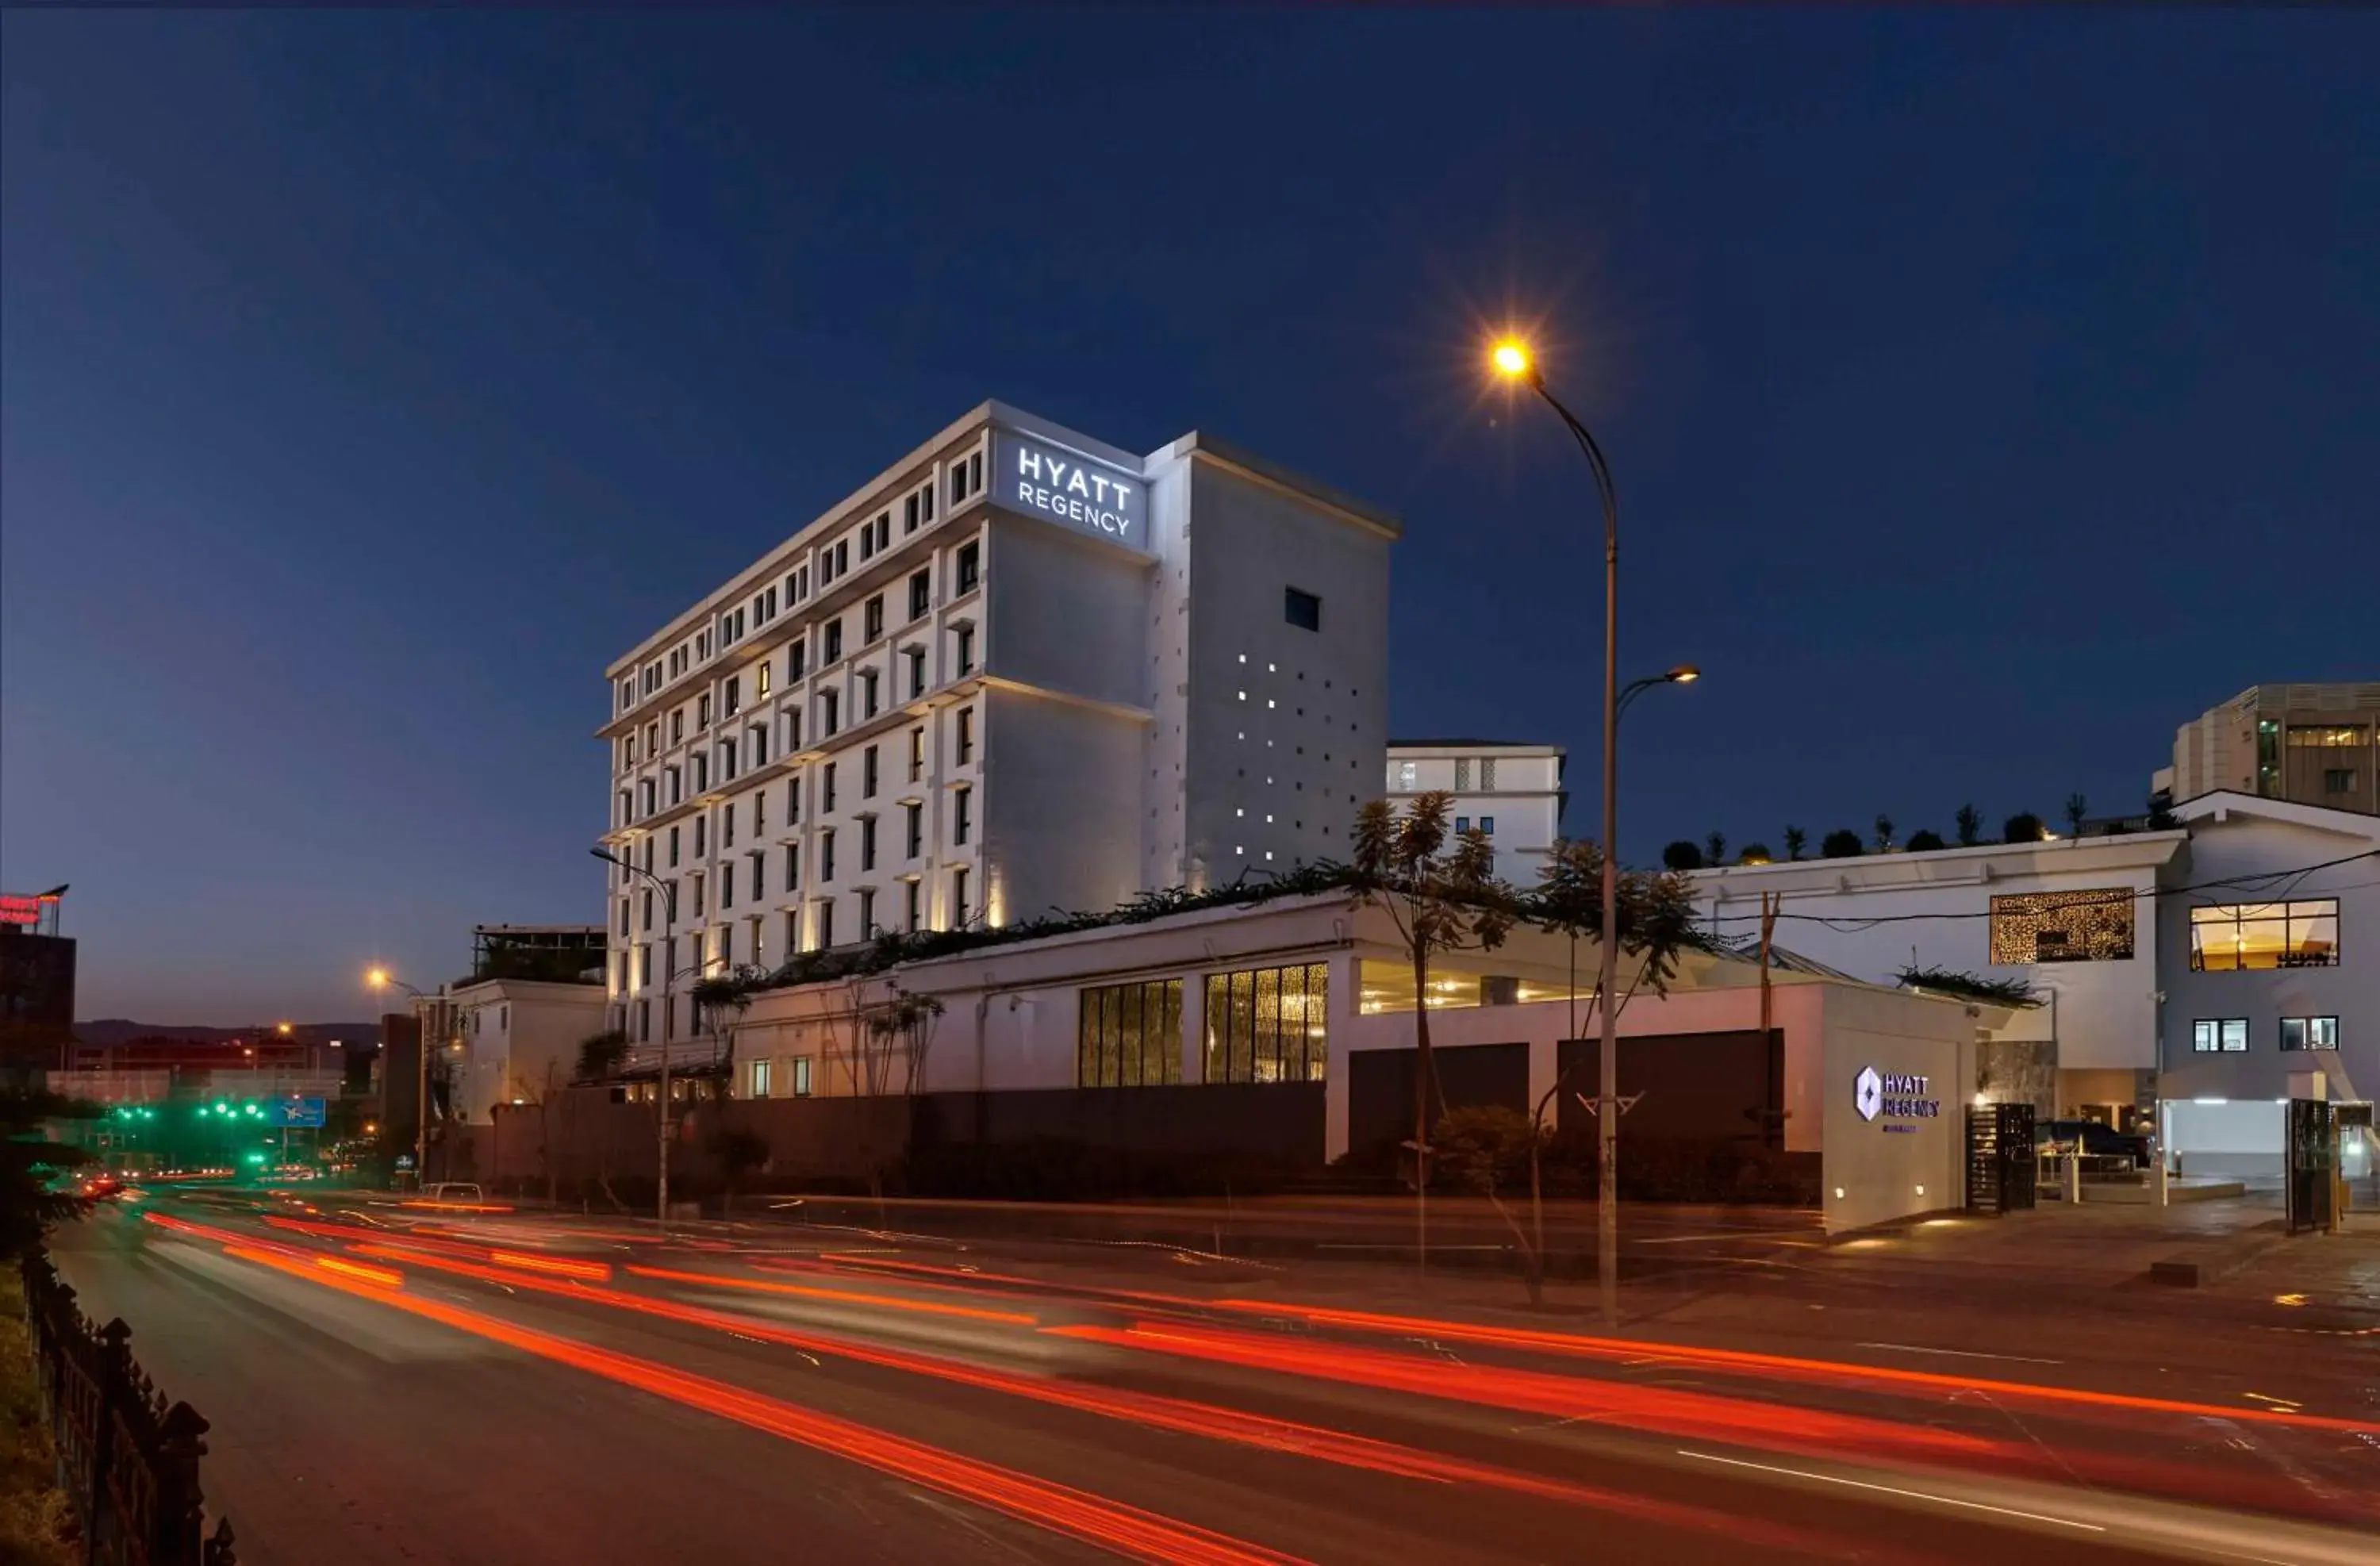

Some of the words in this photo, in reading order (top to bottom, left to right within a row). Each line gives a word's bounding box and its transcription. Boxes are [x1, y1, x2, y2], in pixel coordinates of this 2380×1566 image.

[1019, 447, 1130, 511] HYATT
[1019, 482, 1130, 536] REGENCY
[1884, 1073, 1929, 1095] HYATT
